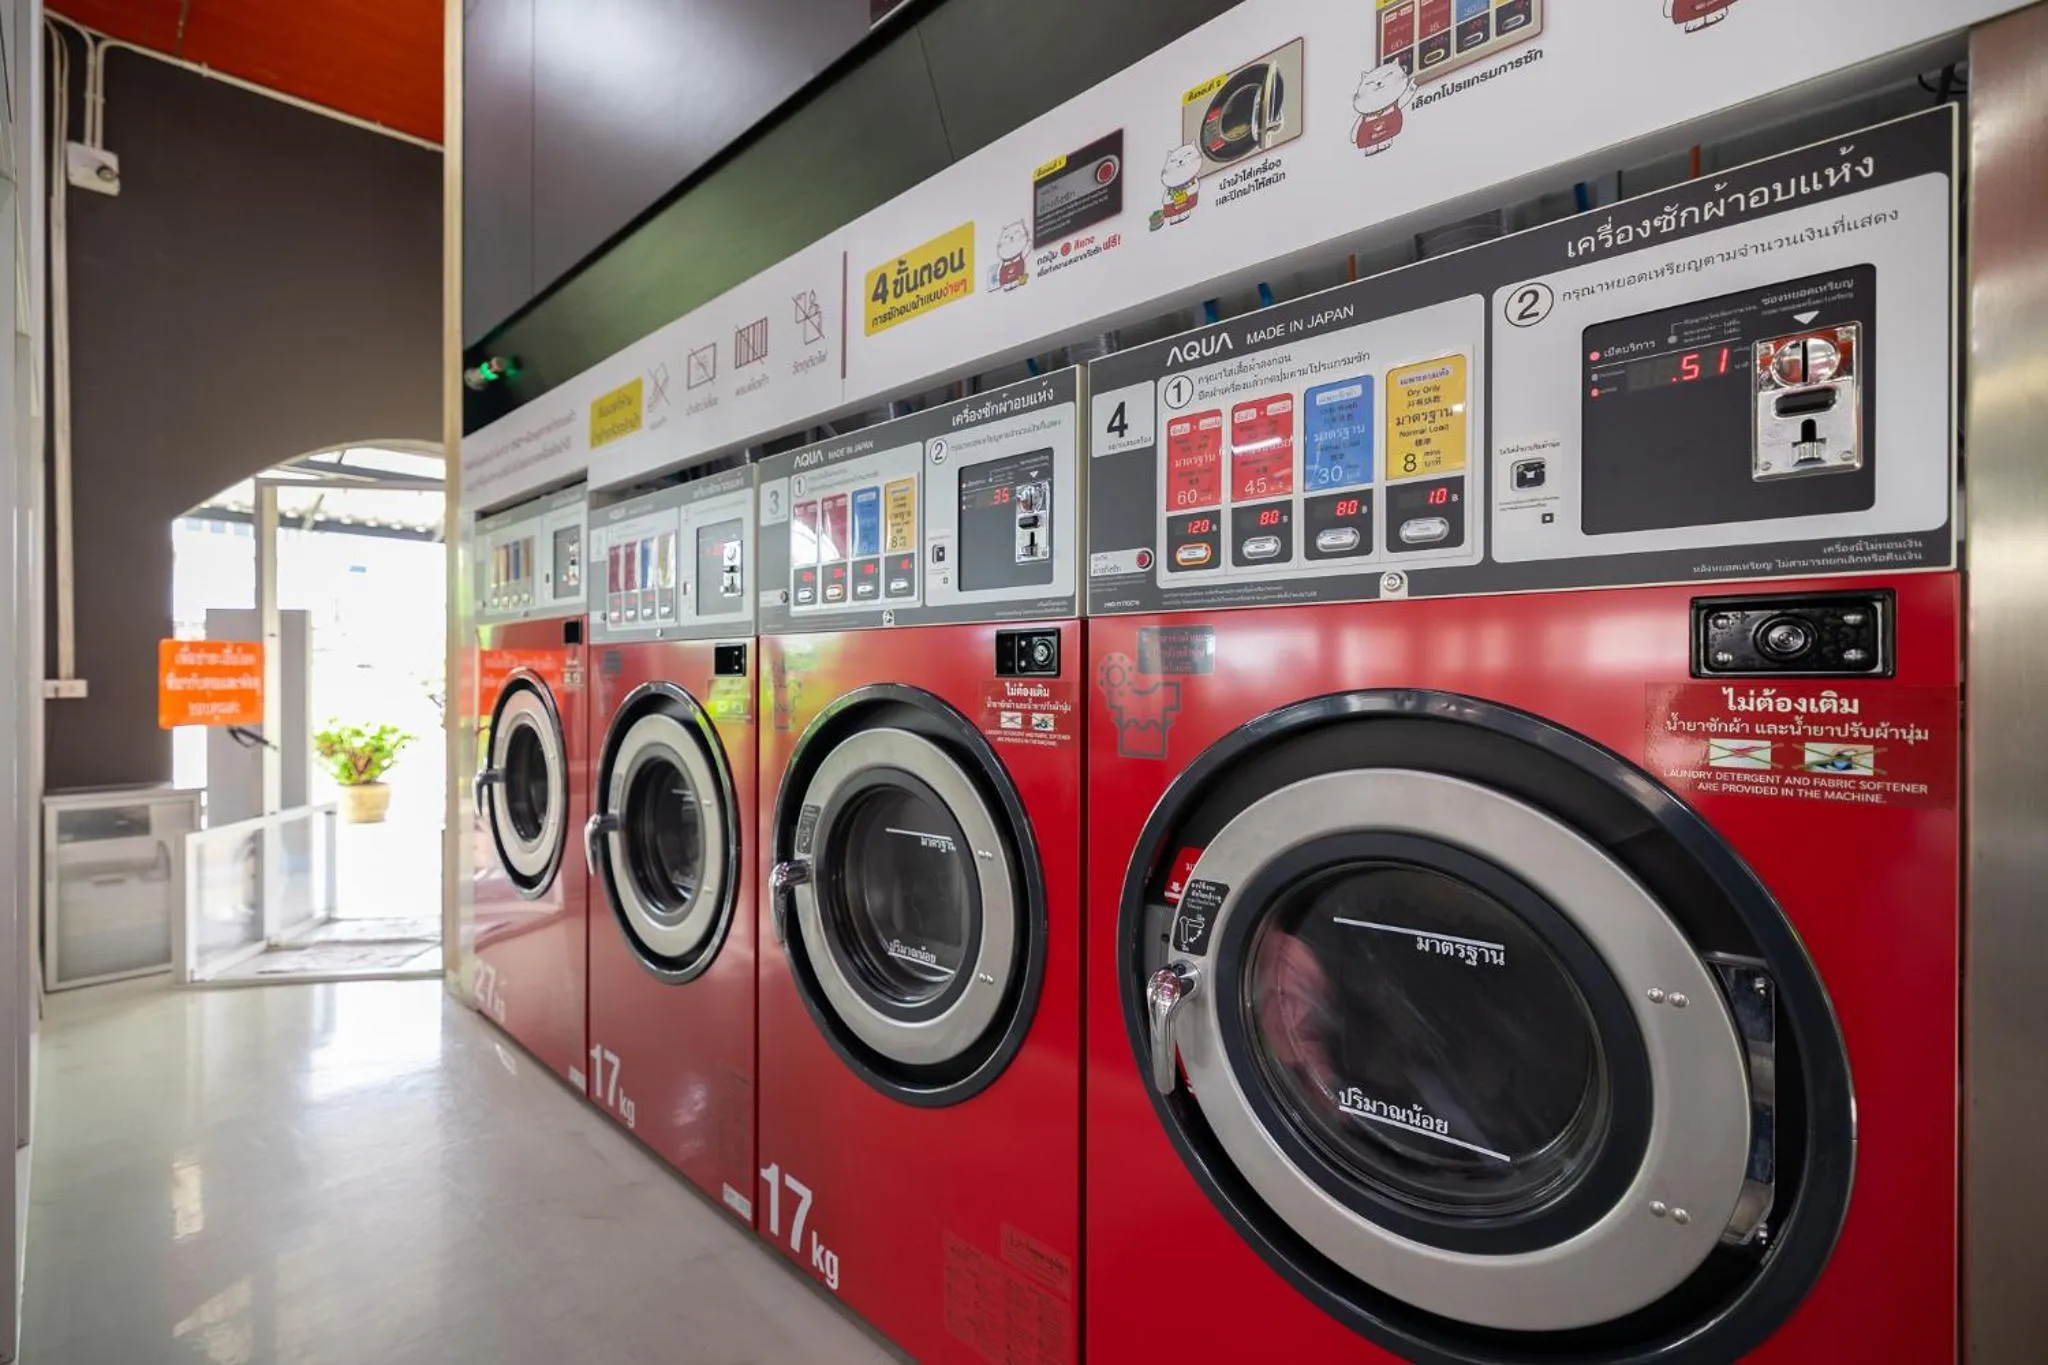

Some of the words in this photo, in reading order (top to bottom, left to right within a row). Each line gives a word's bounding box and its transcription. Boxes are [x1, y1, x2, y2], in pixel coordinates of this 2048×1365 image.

[1411, 47, 1543, 111] เลือกโปรแกรมการซัก
[1566, 144, 1876, 259] เครื่องซักผ้าอบแห้ง
[871, 271, 889, 306] 4
[892, 246, 966, 301] ขั้นตอน
[1516, 289, 1540, 322] 2
[1561, 207, 1900, 302] กรุณาหยอดเหรียญตามจำนวนเงินที่แสดง
[1166, 332, 1233, 367] AQUA
[1246, 323, 1286, 345] MADE
[1289, 318, 1304, 334] IN
[1307, 303, 1355, 329] JAPAN
[951, 380, 1055, 427] เครื่องซักผ้าอบแห้ง
[1171, 380, 1183, 404] 1
[1106, 400, 1129, 438] 4
[1396, 407, 1454, 427] มาตรฐาน
[793, 450, 824, 469] AQUA
[933, 443, 944, 464] 2
[1403, 452, 1417, 473] 8
[1244, 477, 1267, 495] 45
[1318, 464, 1344, 485] 30
[769, 490, 780, 516] 3
[1177, 488, 1198, 505] 60
[1427, 487, 1448, 504] 10
[1259, 510, 1279, 525] 80
[1335, 499, 1359, 517] 80
[1186, 519, 1210, 534] 120
[1004, 682, 1050, 698] ไม่ต้องเติม
[1722, 686, 1860, 715] ไม่ต้องเติม
[1665, 711, 1750, 733] น้ำยาซักผ้า
[1755, 714, 1930, 745] และน้ำยาปรับผ้านุ่ม
[1696, 782, 1718, 792] ARE
[1721, 783, 1780, 797] PROVIDED
[1781, 787, 1795, 798] IN
[1798, 788, 1822, 800] THE
[1715, 771, 1782, 785] DETERGENT
[1785, 775, 1811, 787] AND
[1813, 777, 1857, 790] FABRIC
[1859, 779, 1929, 794] SOFTENER
[1415, 934, 1506, 967] มาตรฐาน
[589, 1043, 621, 1107] 17
[619, 1089, 636, 1129] kg
[1338, 1087, 1450, 1136] ปริมาณน้อย
[759, 1161, 813, 1254] 17
[811, 1230, 840, 1290] kg
